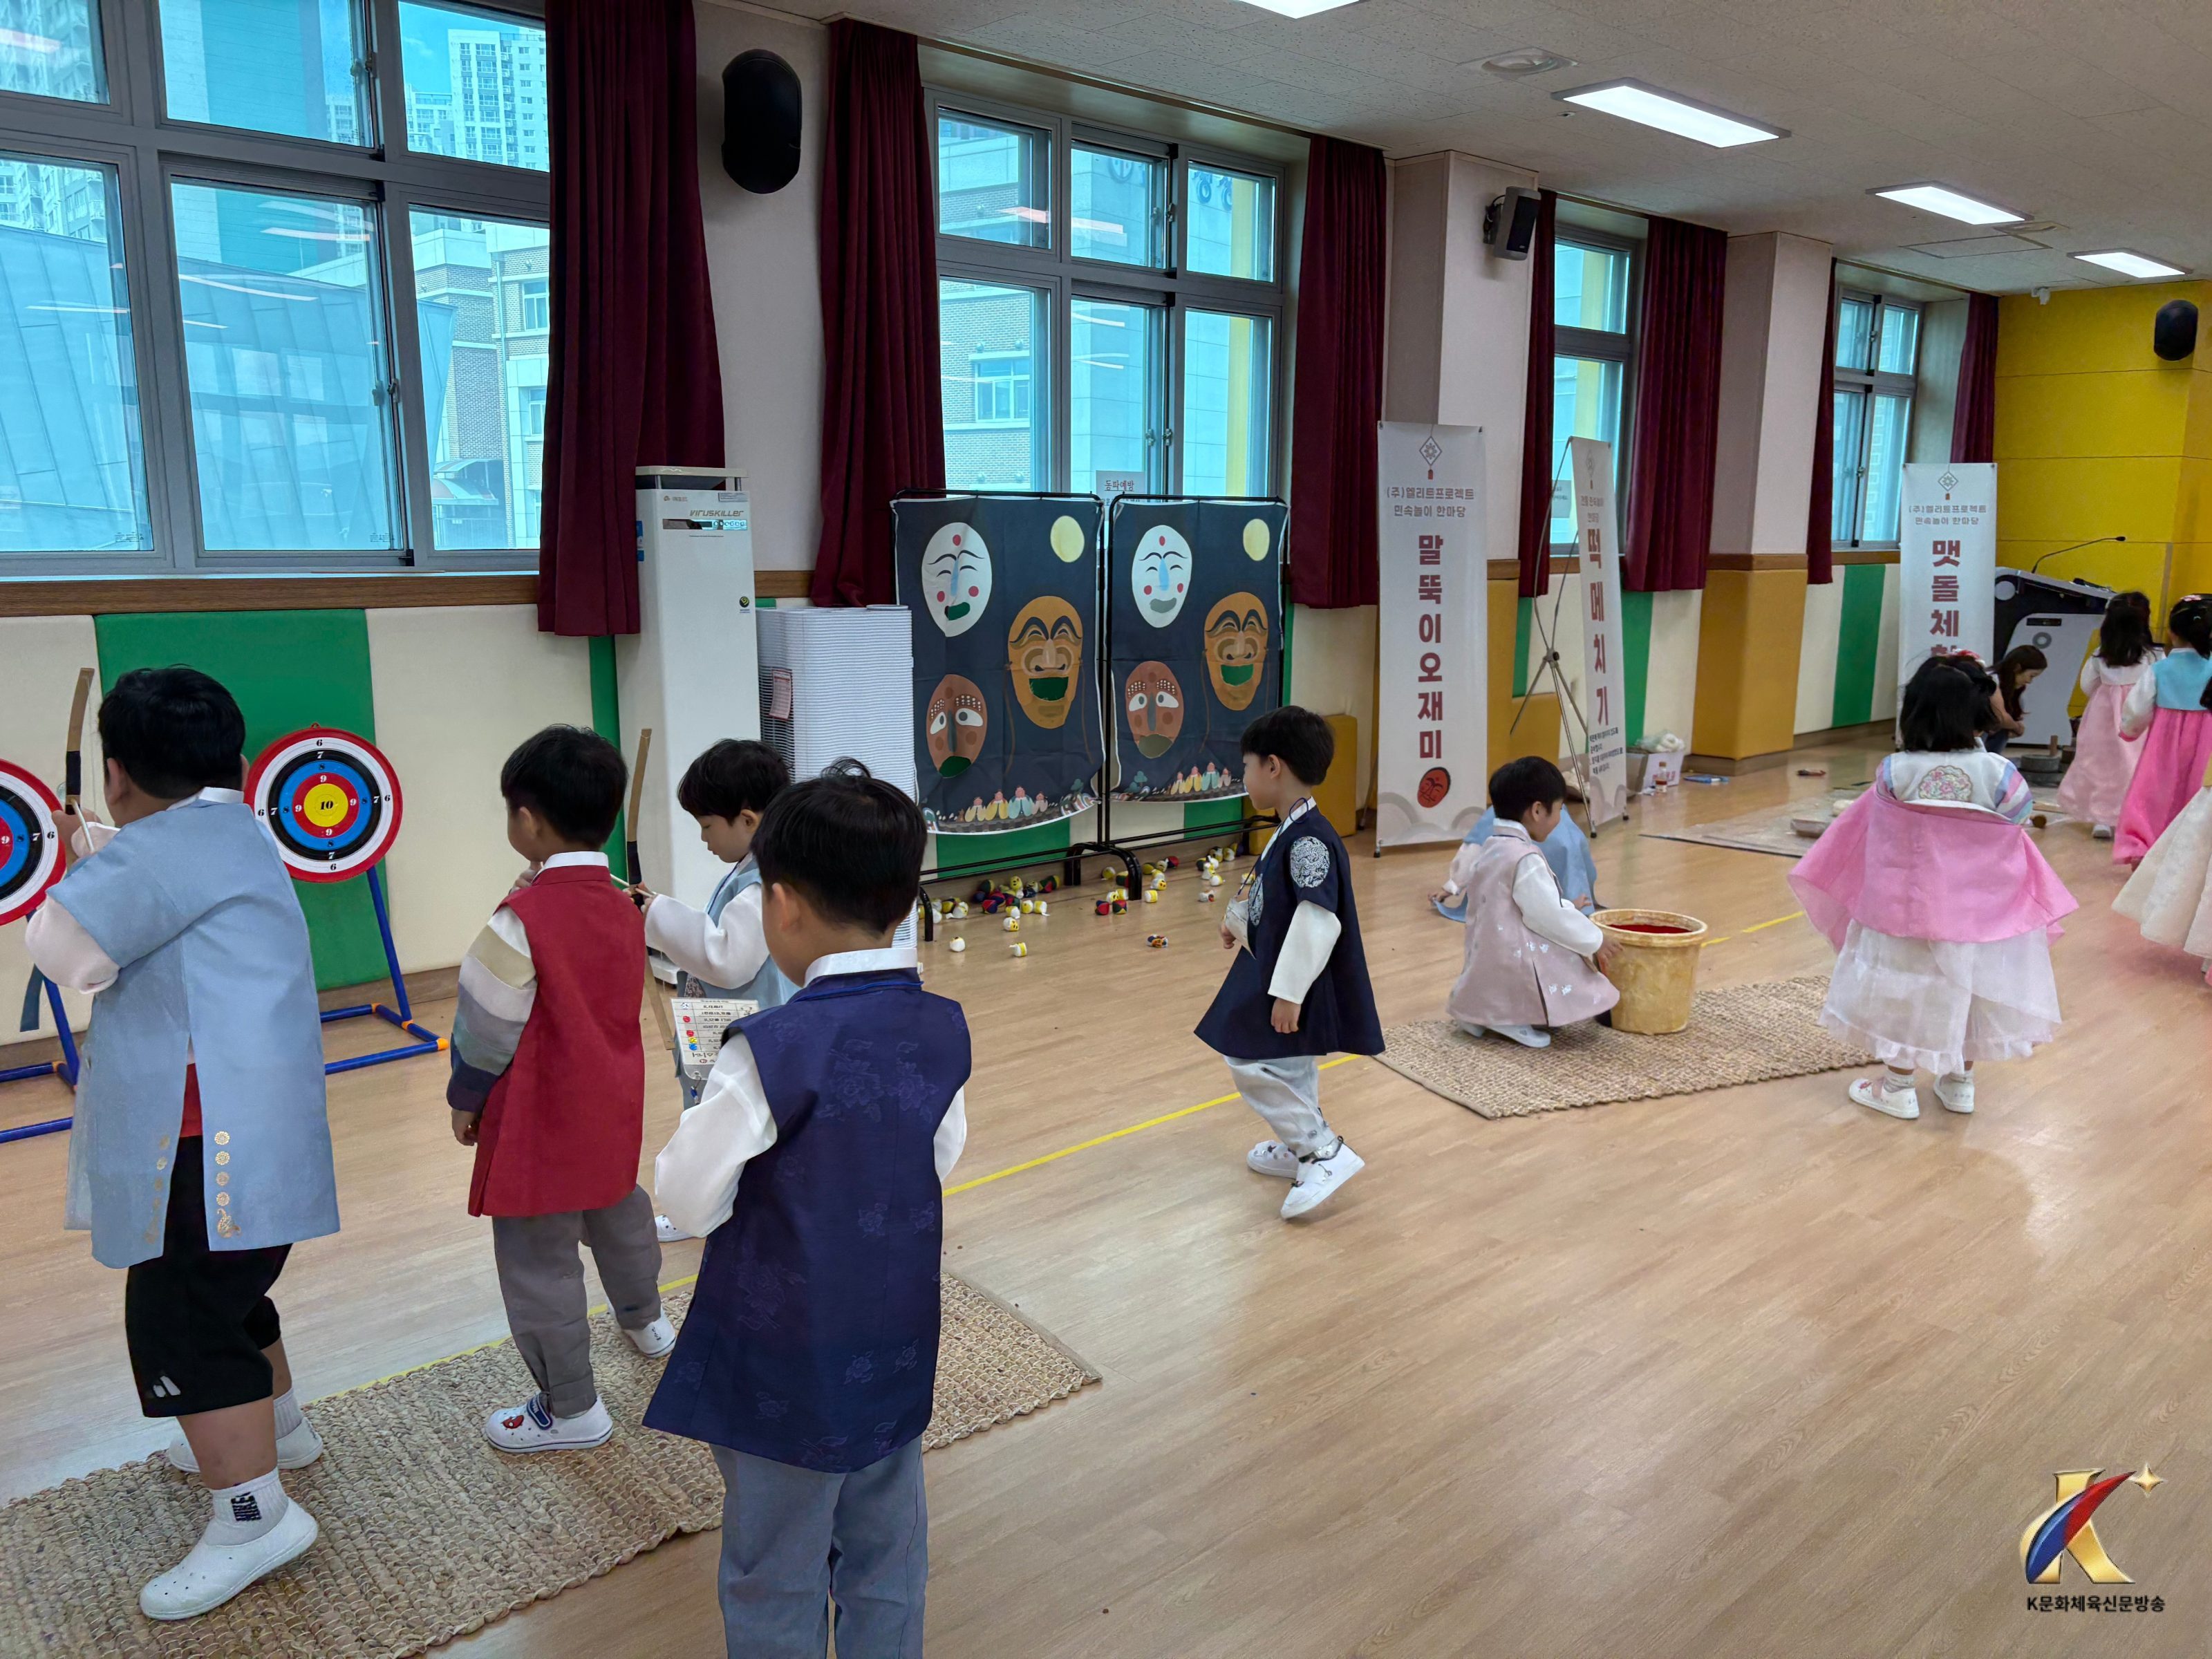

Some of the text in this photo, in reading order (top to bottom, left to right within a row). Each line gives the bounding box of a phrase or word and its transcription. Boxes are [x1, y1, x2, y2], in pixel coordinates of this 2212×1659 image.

[1394, 505, 1466, 518] 민속놀이 한마당
[317, 751, 324, 759] 7
[320, 800, 334, 810] 10
[270, 807, 278, 816] 7
[1, 835, 10, 844] 9
[17, 834, 24, 843] 8
[32, 832, 41, 841] 7
[47, 831, 55, 839] 6
